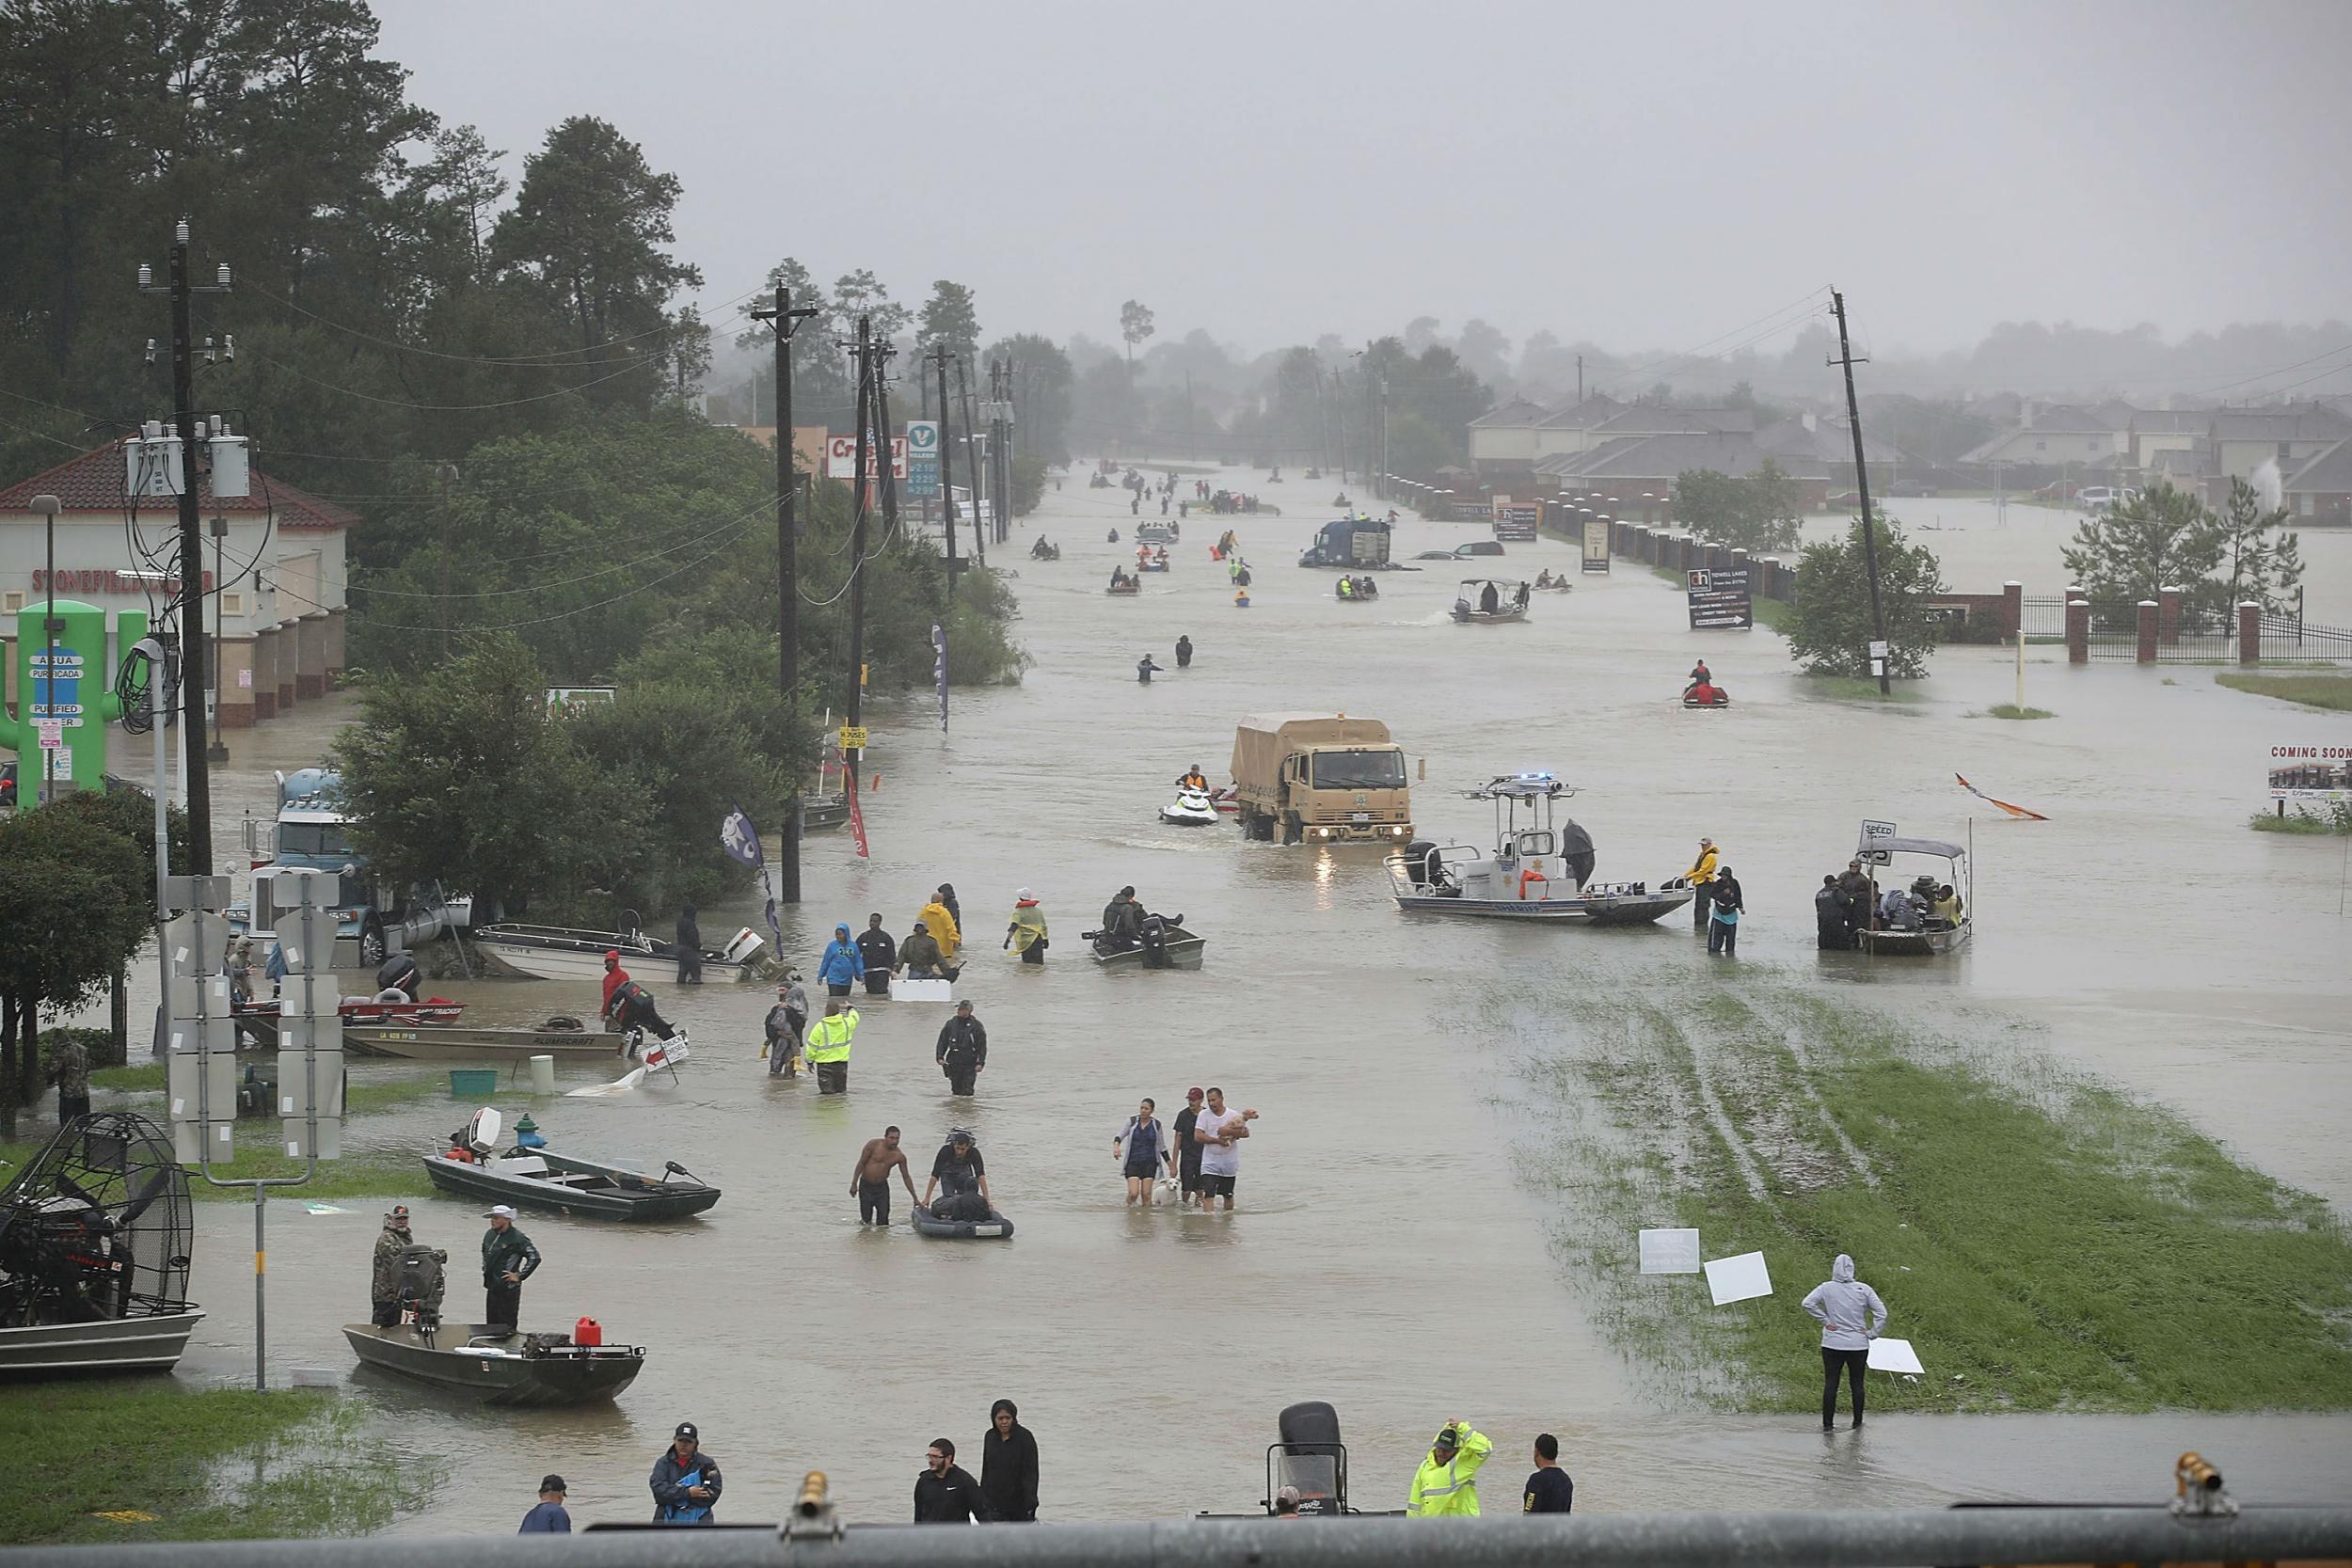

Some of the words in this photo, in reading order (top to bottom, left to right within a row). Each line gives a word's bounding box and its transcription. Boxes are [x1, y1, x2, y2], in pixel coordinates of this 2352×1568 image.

[2271, 747, 2317, 758] COMING
[2322, 747, 2352, 758] SOON
[1865, 825, 1892, 834] SPEED
[1496, 904, 1543, 912] SHERIFF
[533, 1037, 596, 1046] ALUMACRAFT
[662, 1037, 682, 1049] TRUCK
[666, 1043, 685, 1055] DIESEL
